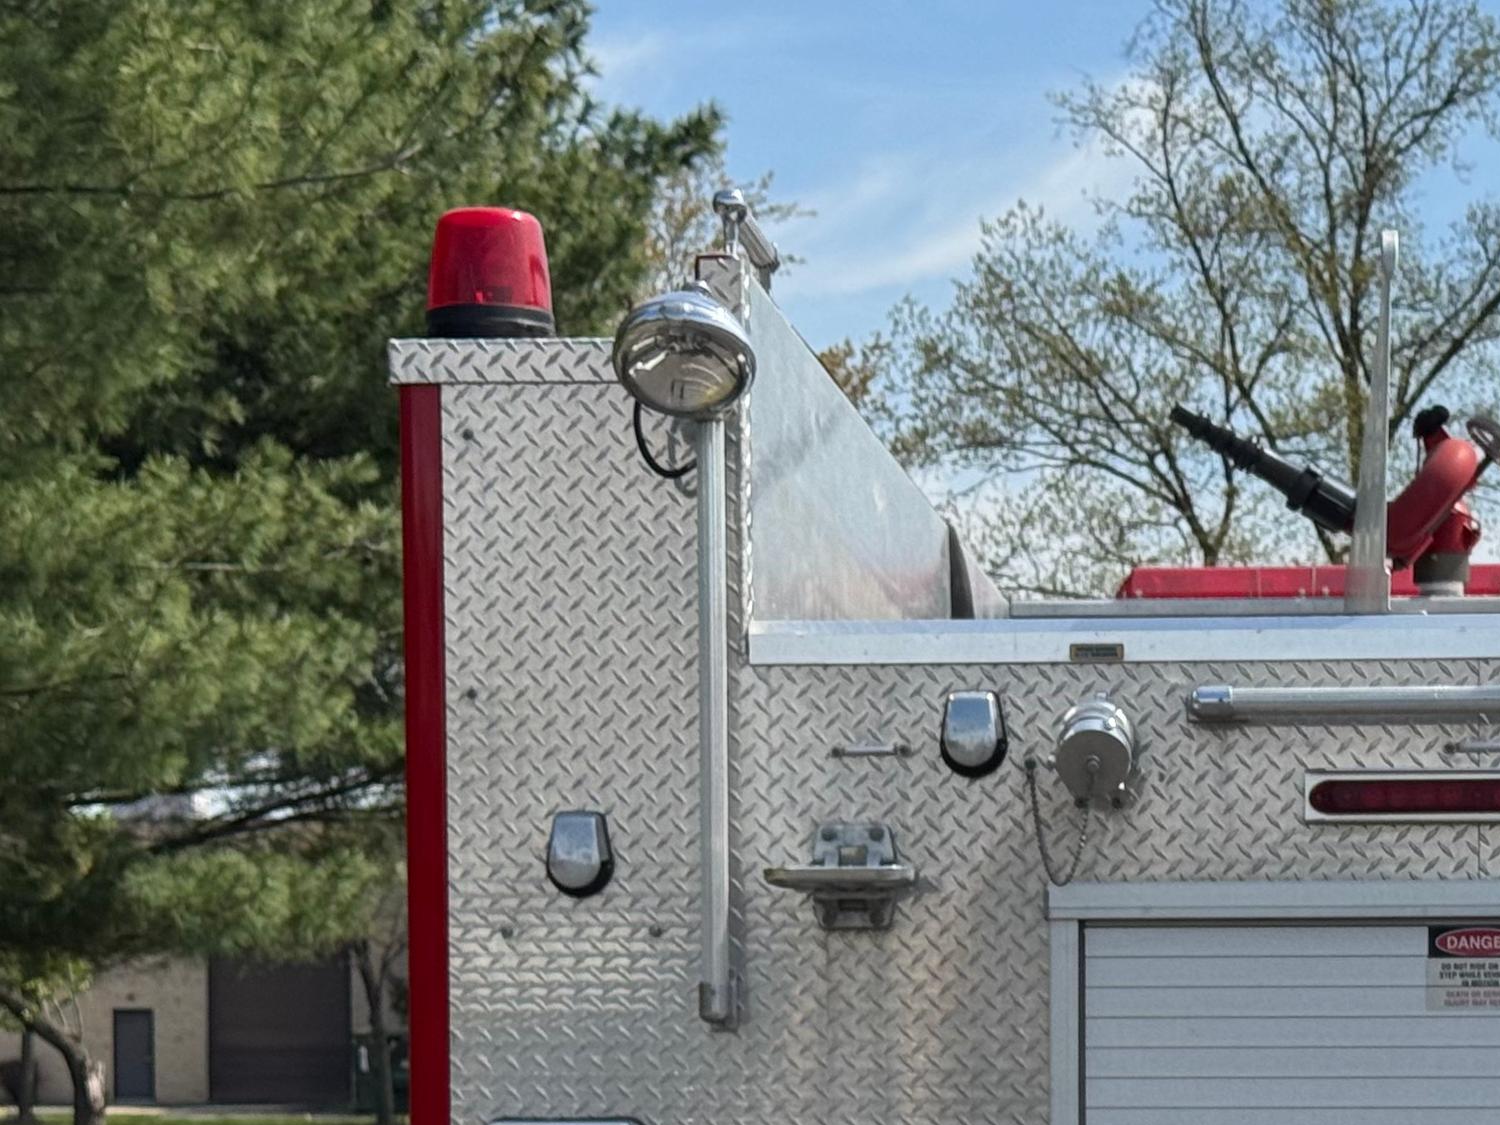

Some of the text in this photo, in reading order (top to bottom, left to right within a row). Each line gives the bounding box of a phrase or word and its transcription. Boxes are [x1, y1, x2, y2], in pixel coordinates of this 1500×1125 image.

[1441, 962, 1452, 970] DO
[1453, 962, 1468, 970] NOT
[1439, 971, 1457, 980] STEP
[1459, 971, 1481, 979] WHILE
